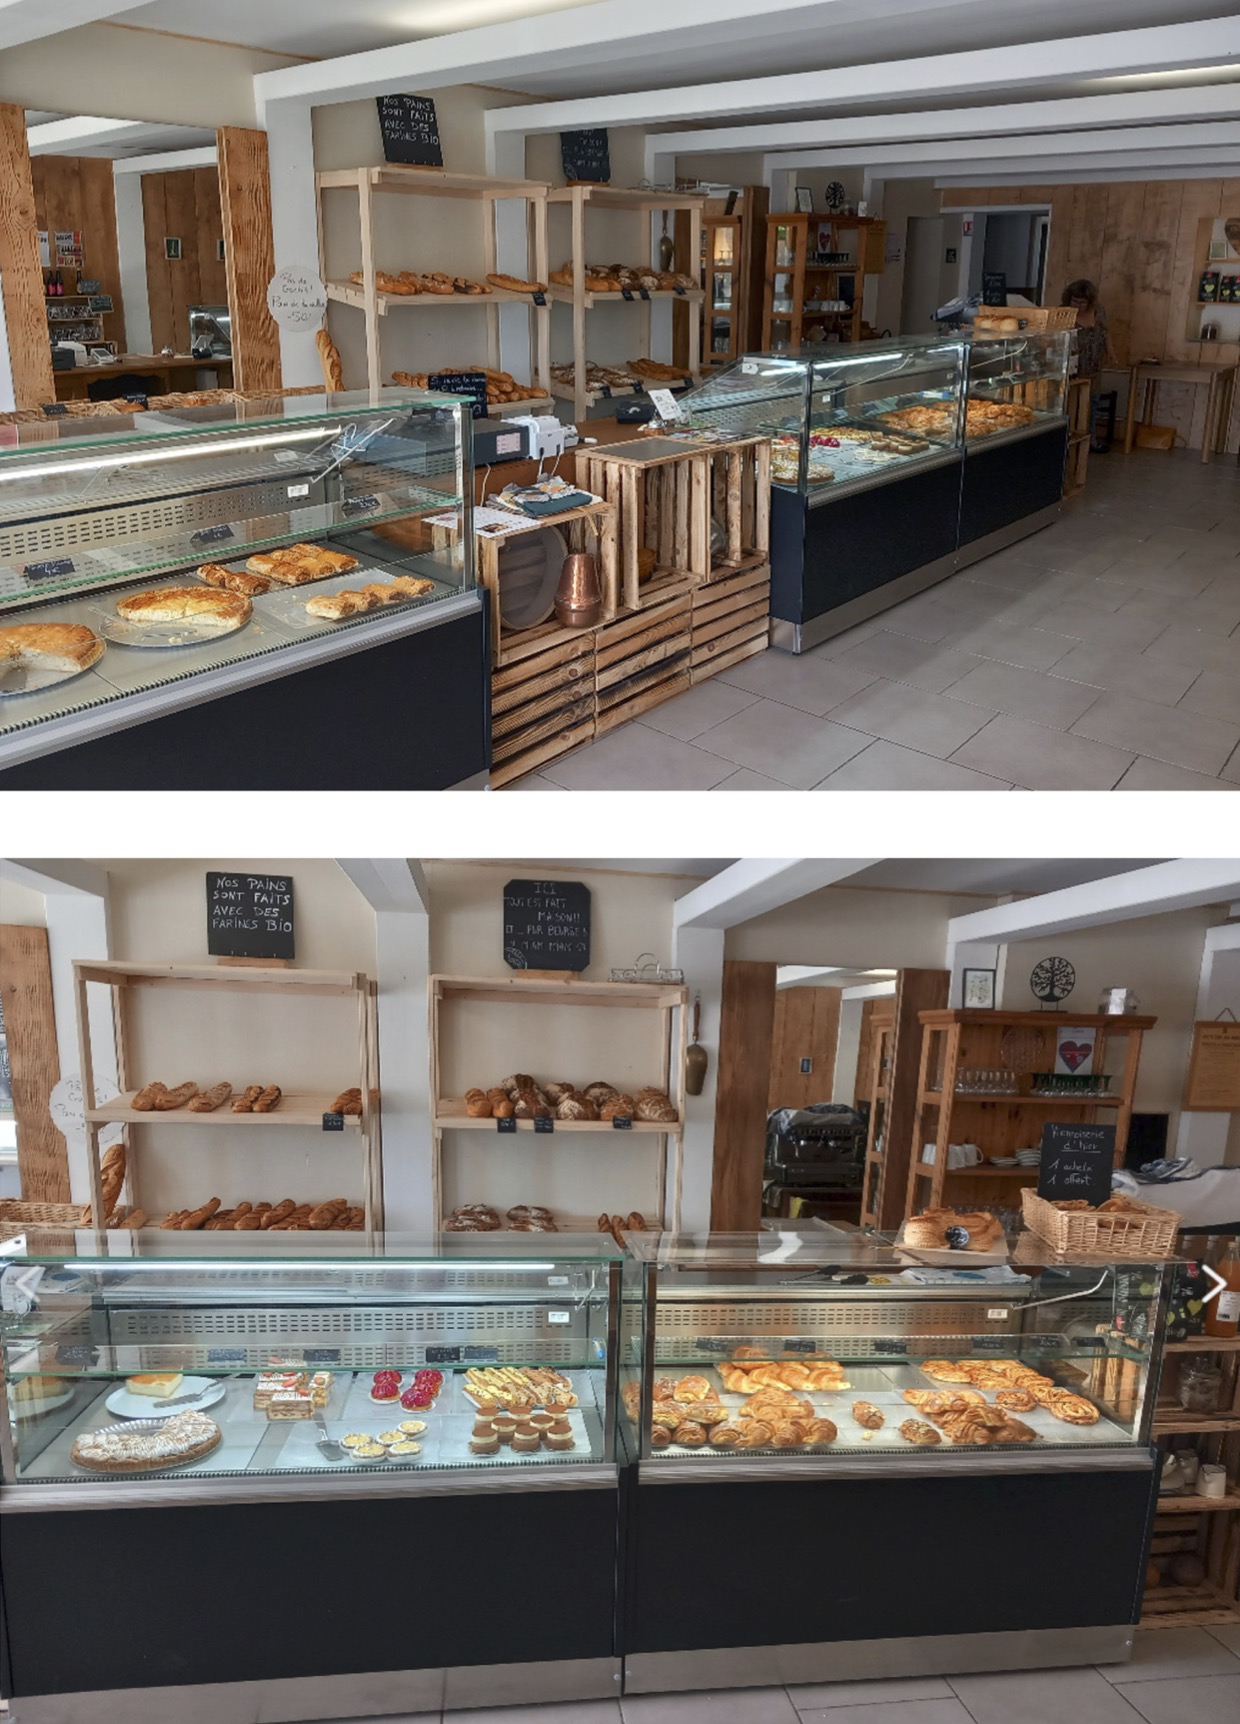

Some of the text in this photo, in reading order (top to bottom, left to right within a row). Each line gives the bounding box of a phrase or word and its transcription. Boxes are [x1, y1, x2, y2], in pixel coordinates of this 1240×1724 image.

[403, 97, 431, 111] PAINS
[382, 107, 404, 116] SONT
[384, 119, 429, 132] AVEC DES
[216, 876, 287, 891] NOS PAINS
[533, 882, 557, 895] ICI
[212, 890, 245, 901] SONT
[545, 898, 567, 909] FAIT
[213, 904, 280, 917] AVEC DES
[212, 916, 259, 930] FARINES
[1048, 1158, 1060, 1170] 1
[1047, 1174, 1057, 1185] 1
